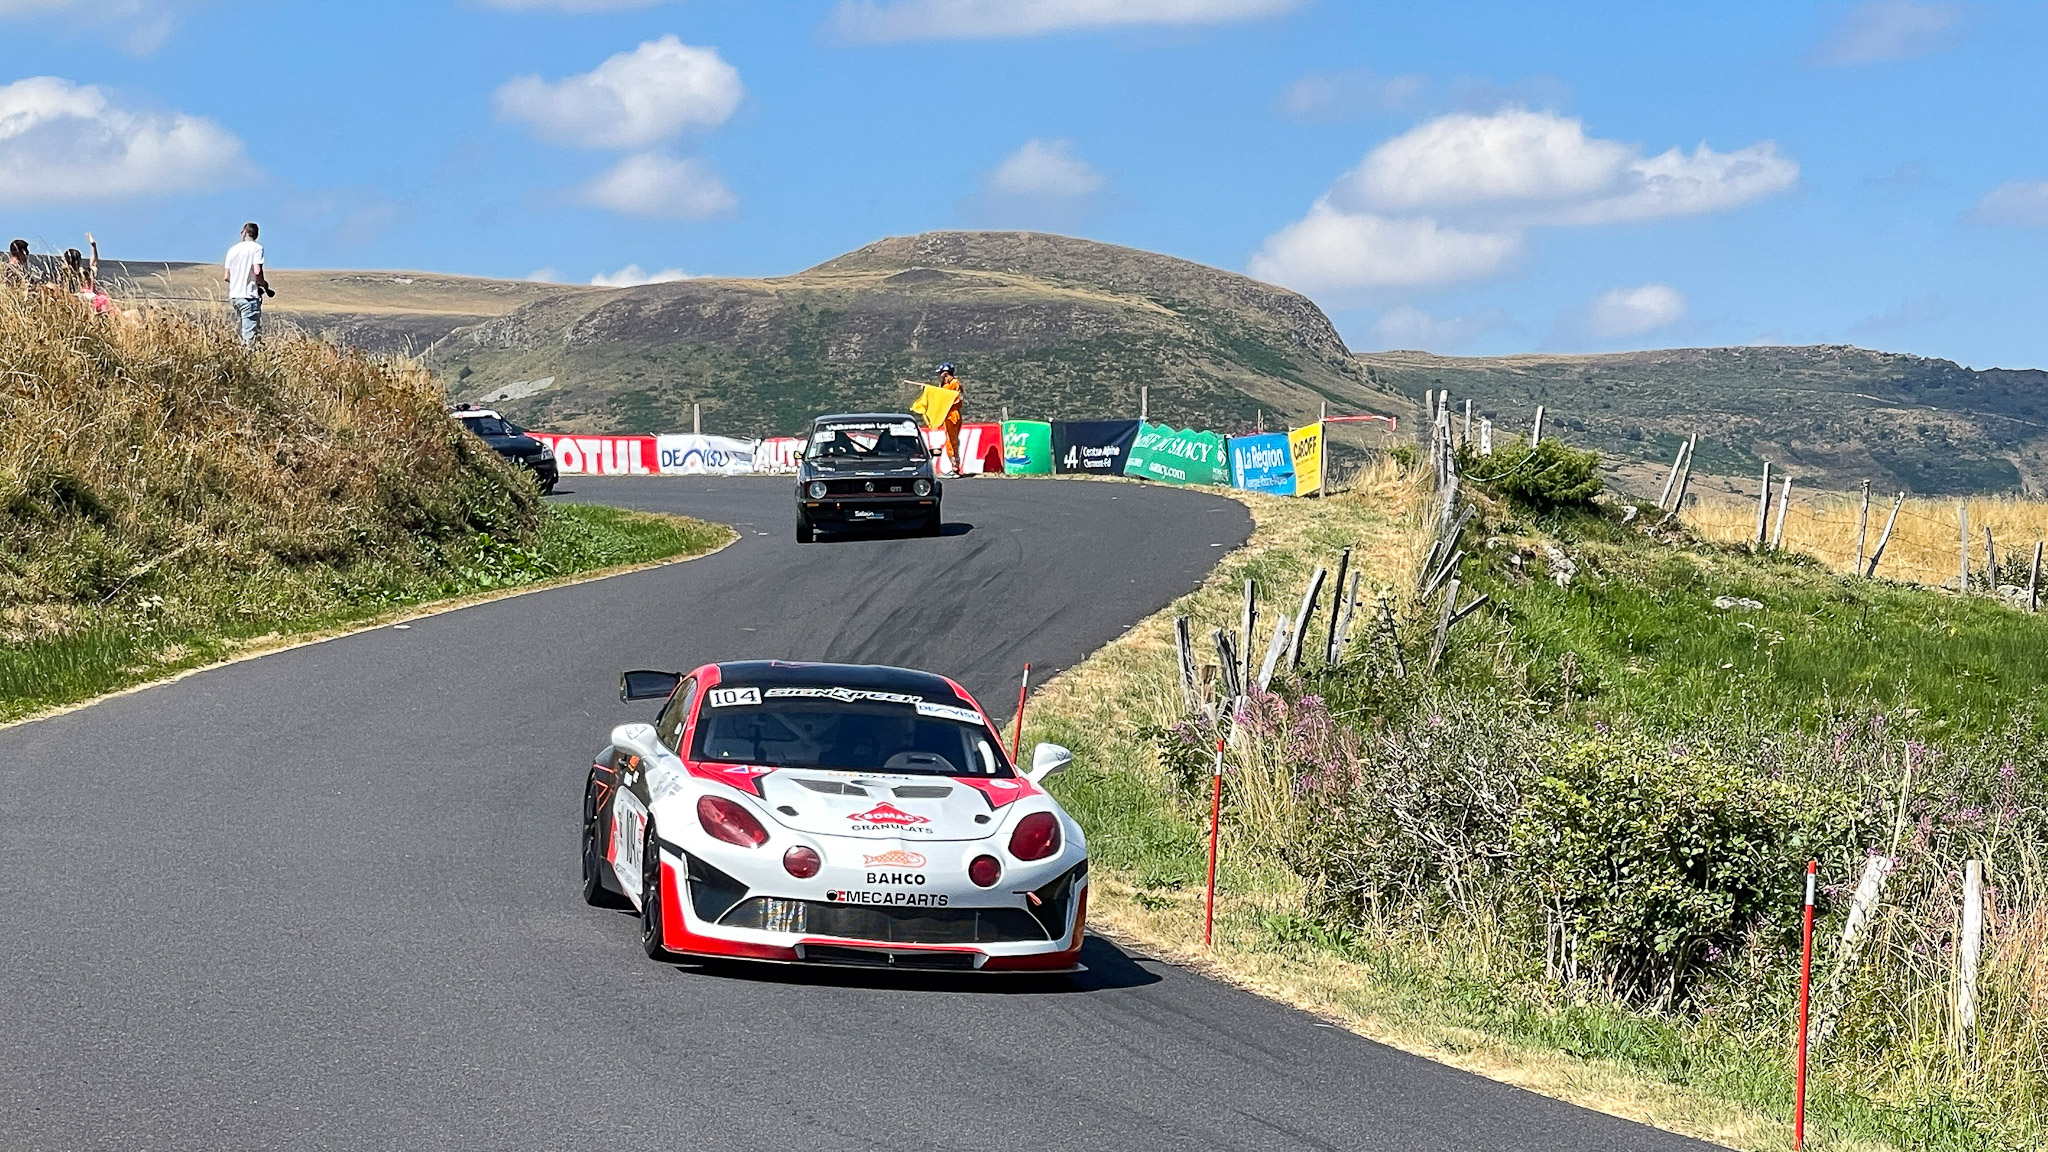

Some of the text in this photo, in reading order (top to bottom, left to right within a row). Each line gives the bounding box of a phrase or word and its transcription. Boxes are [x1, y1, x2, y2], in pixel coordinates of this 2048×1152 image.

[1168, 438, 1213, 463] SANCY
[1243, 443, 1285, 473] La Région
[1149, 462, 1186, 481] sancy.com
[714, 690, 757, 704] 104
[862, 812, 915, 823] SOMAC
[851, 823, 934, 834] GRANULATS
[866, 872, 926, 886] BAHCO
[846, 890, 949, 907] MECAPARTS
